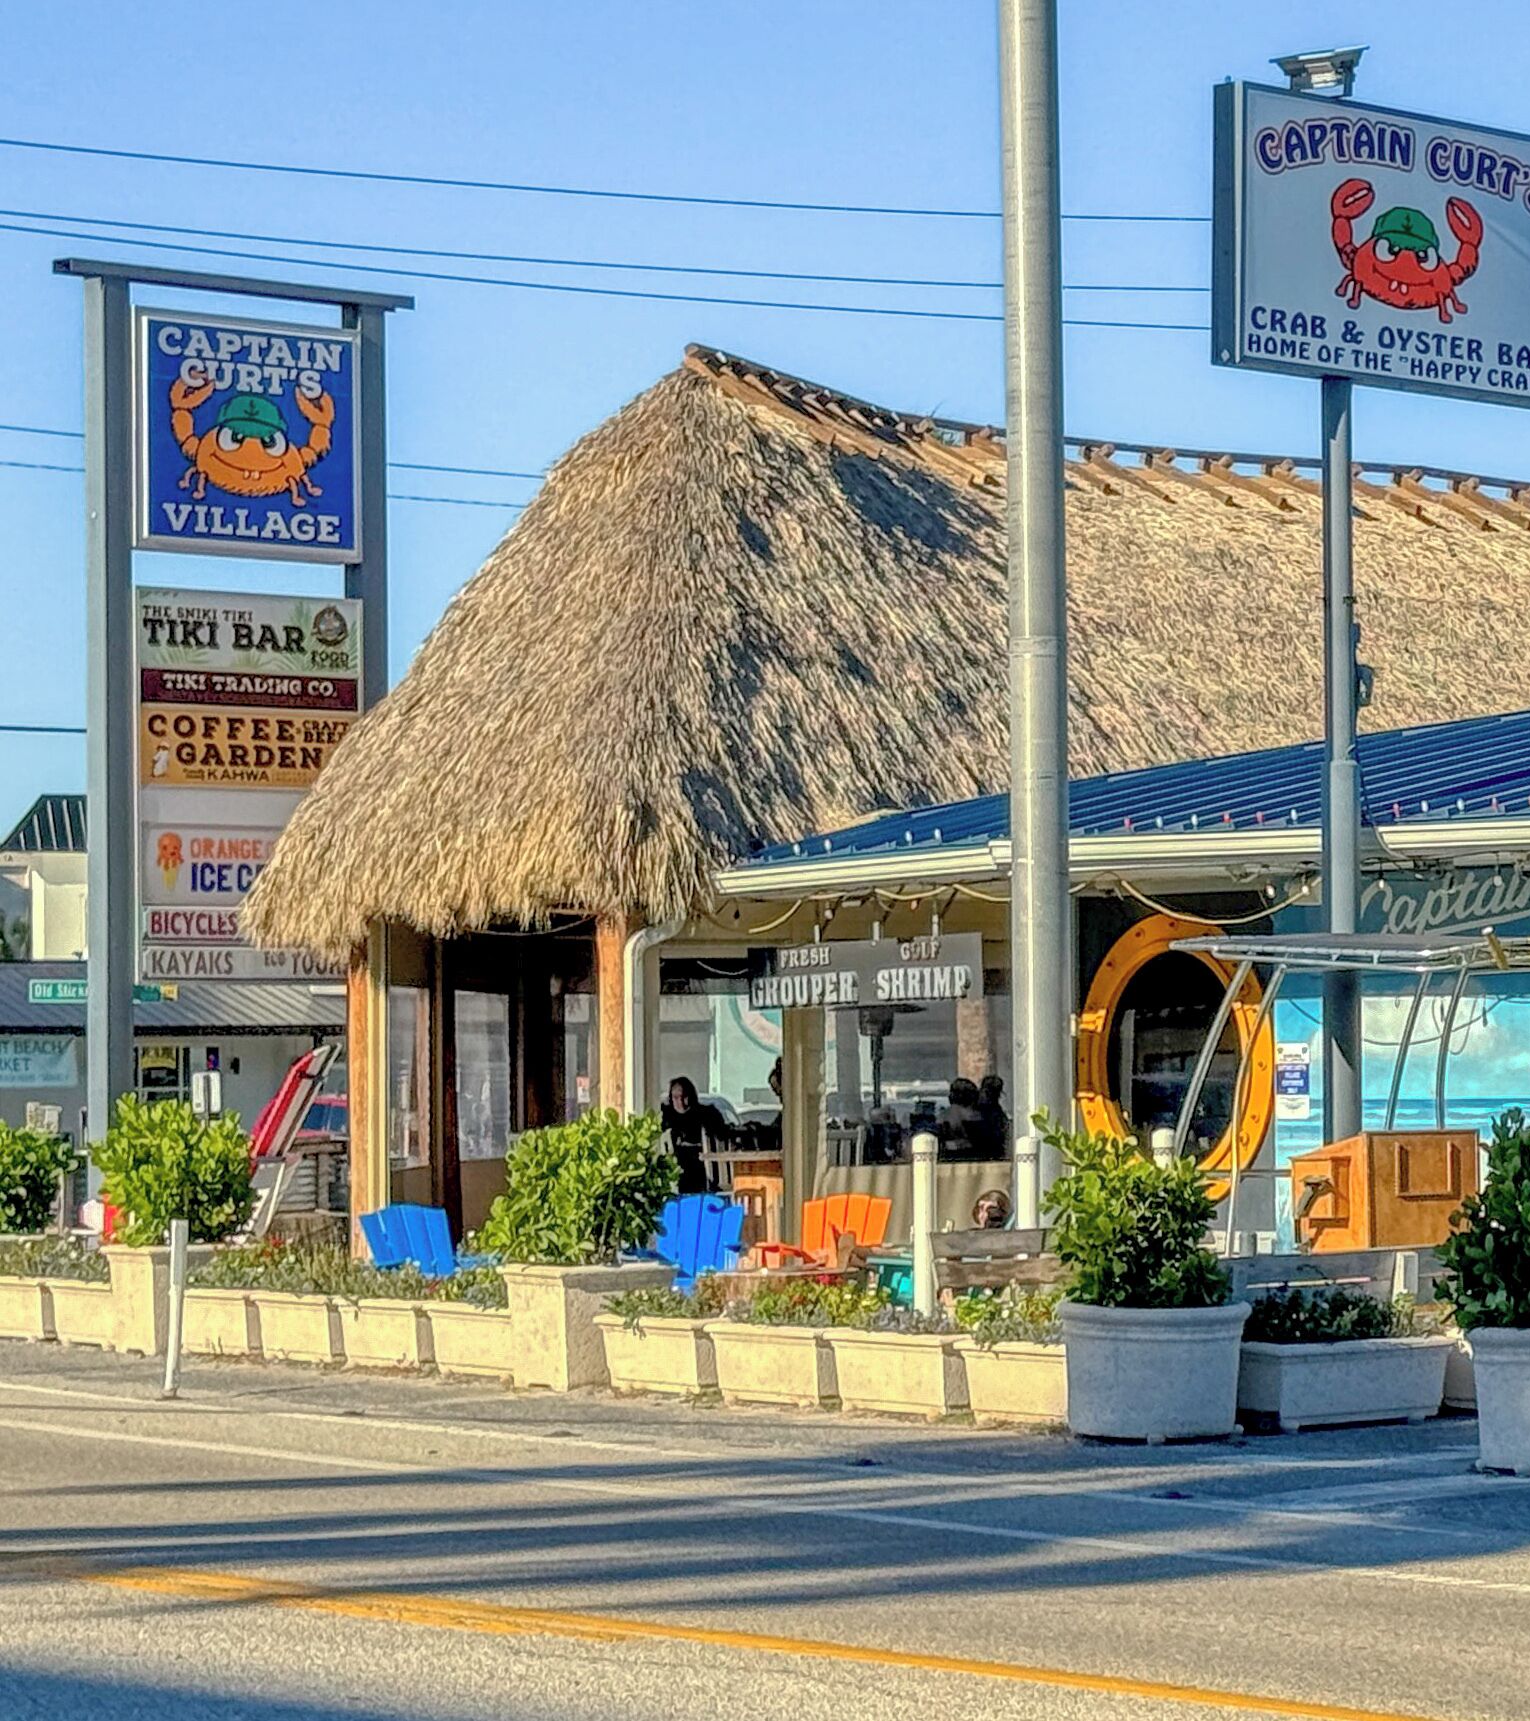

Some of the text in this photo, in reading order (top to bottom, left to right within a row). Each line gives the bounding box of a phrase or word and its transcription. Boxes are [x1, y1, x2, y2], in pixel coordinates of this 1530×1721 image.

[1256, 118, 1415, 174] CAPTAIN
[1251, 306, 1327, 339] CRAB
[1342, 320, 1363, 343] &
[1378, 326, 1483, 362] OYSTER
[158, 326, 343, 373] CAPTAIN
[1248, 332, 1310, 361] HOME
[1318, 344, 1344, 365] OF
[1351, 349, 1392, 373] THE
[1400, 355, 1481, 385] "HAPPY
[180, 358, 323, 400] CURT'S
[162, 502, 340, 544] VILLAGE
[143, 605, 171, 618] THE
[222, 609, 253, 623] TIKI
[143, 618, 306, 654] TIKI BAR
[163, 673, 338, 697] TIKI TRADING CO.
[148, 714, 297, 743] COFFEE
[176, 742, 322, 769] GARDEN
[207, 768, 270, 782] KAHWA
[190, 838, 262, 859] ORANGE
[191, 862, 233, 892] ICE
[151, 911, 238, 935] BICYCLES
[152, 951, 234, 976] KAYAKS
[780, 940, 941, 968] FRESH GULF
[34, 984, 50, 998] Old
[750, 964, 972, 1009] GROUPER SHRIMP
